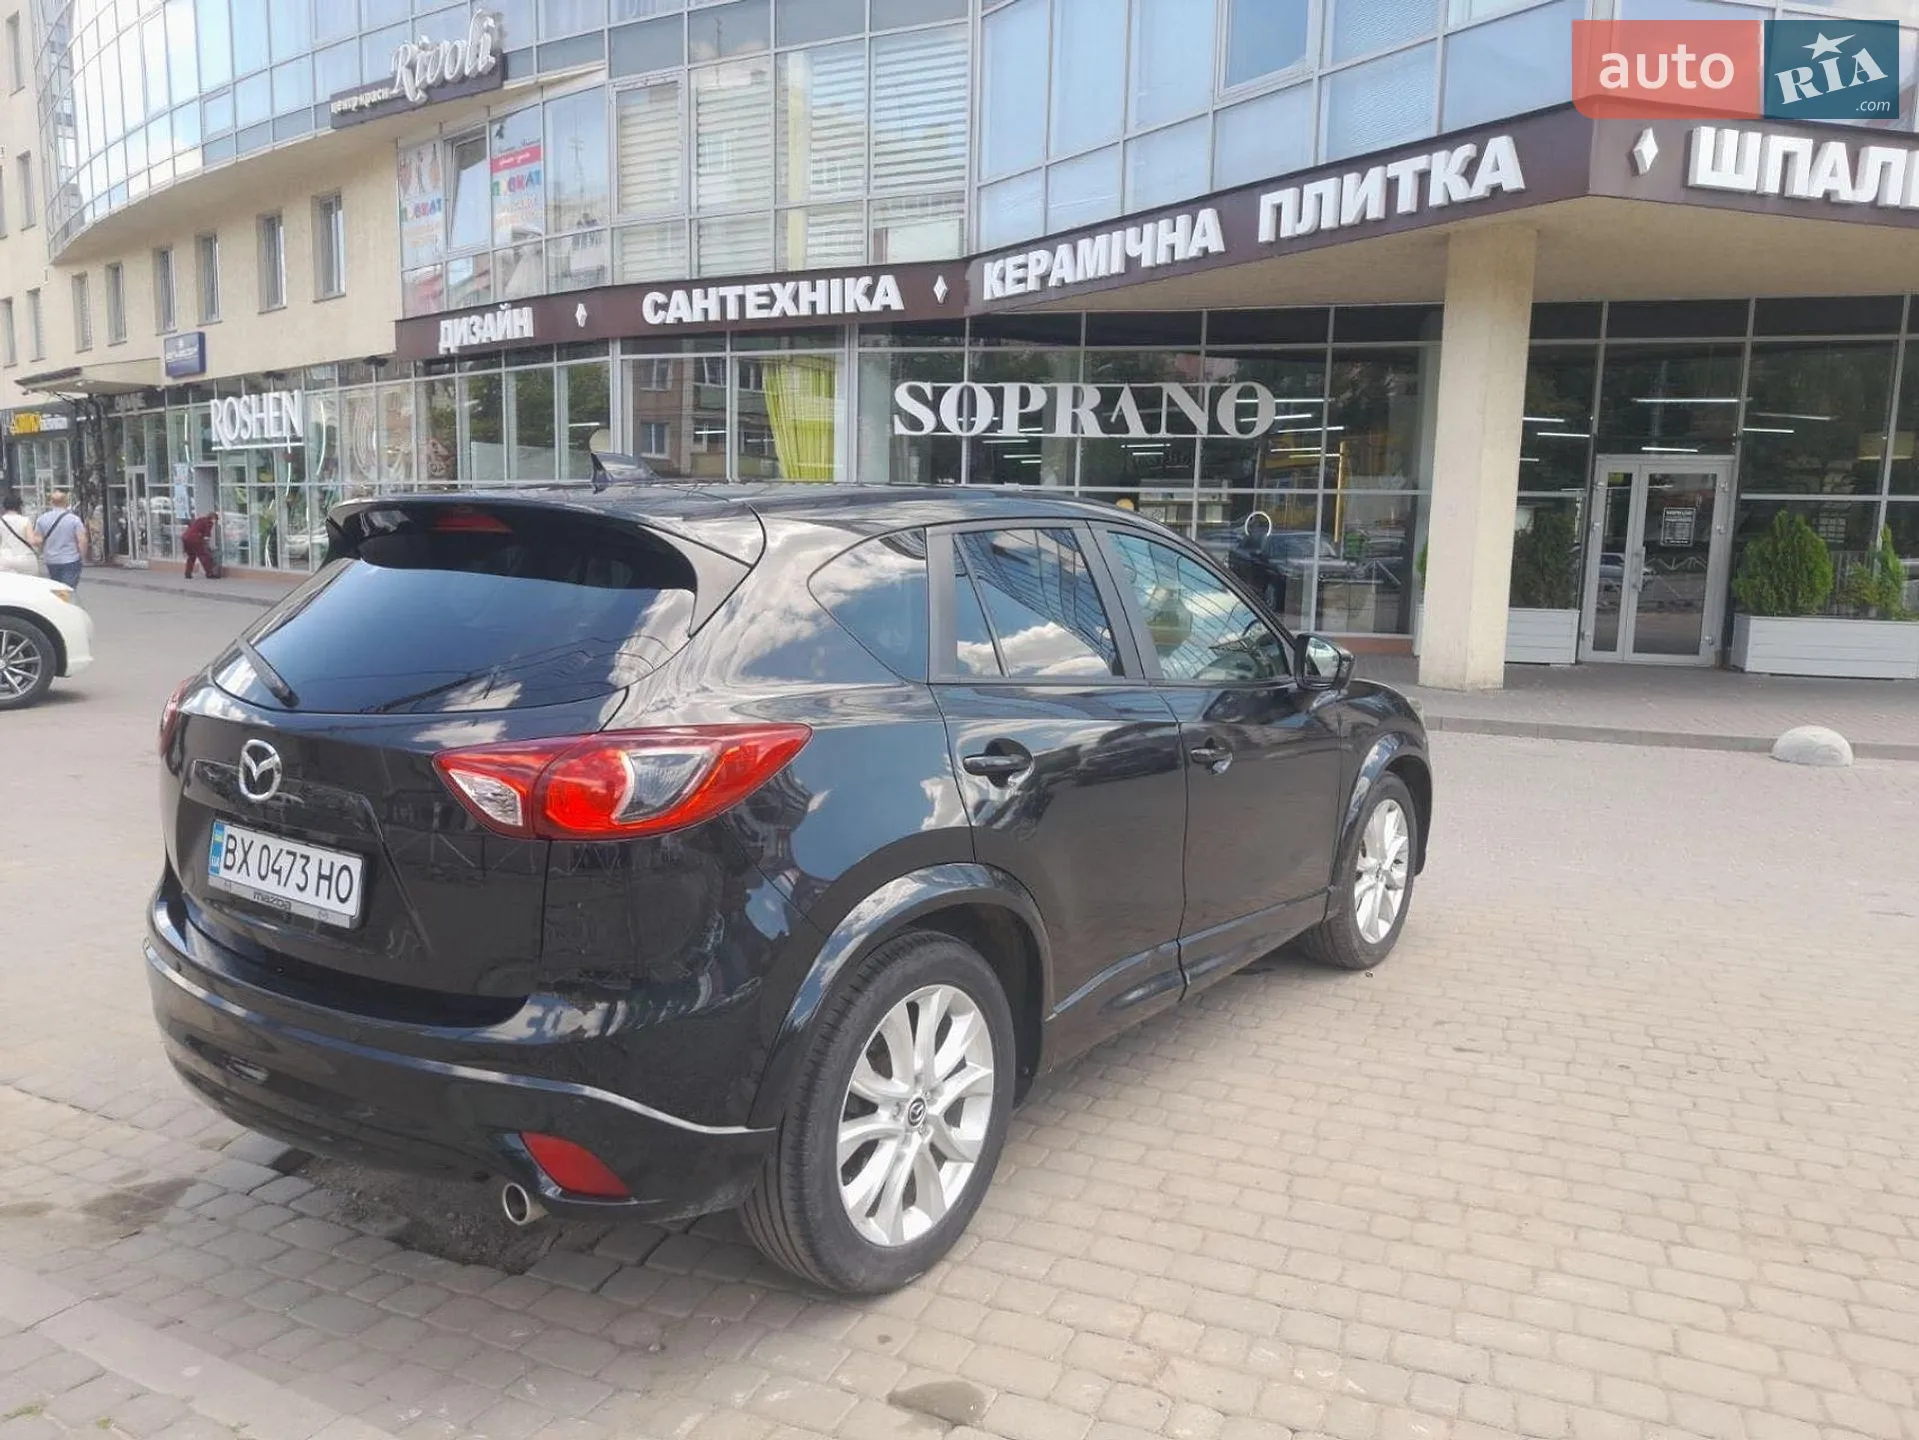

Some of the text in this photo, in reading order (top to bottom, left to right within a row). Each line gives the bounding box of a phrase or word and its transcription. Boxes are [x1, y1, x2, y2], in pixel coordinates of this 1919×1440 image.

[391, 9, 496, 104] Rivoli
[438, 303, 534, 355] ДИЗАЙН
[642, 274, 904, 326] САНТЕХНІКА
[983, 207, 1226, 301] КЕРАМІЧНА
[1258, 135, 1527, 244] ПЛИТКА
[209, 389, 304, 449] ROSHEN
[893, 380, 1276, 439] SOPRANO
[223, 833, 354, 904] BX 0473 HO
[253, 890, 292, 912] mazda
